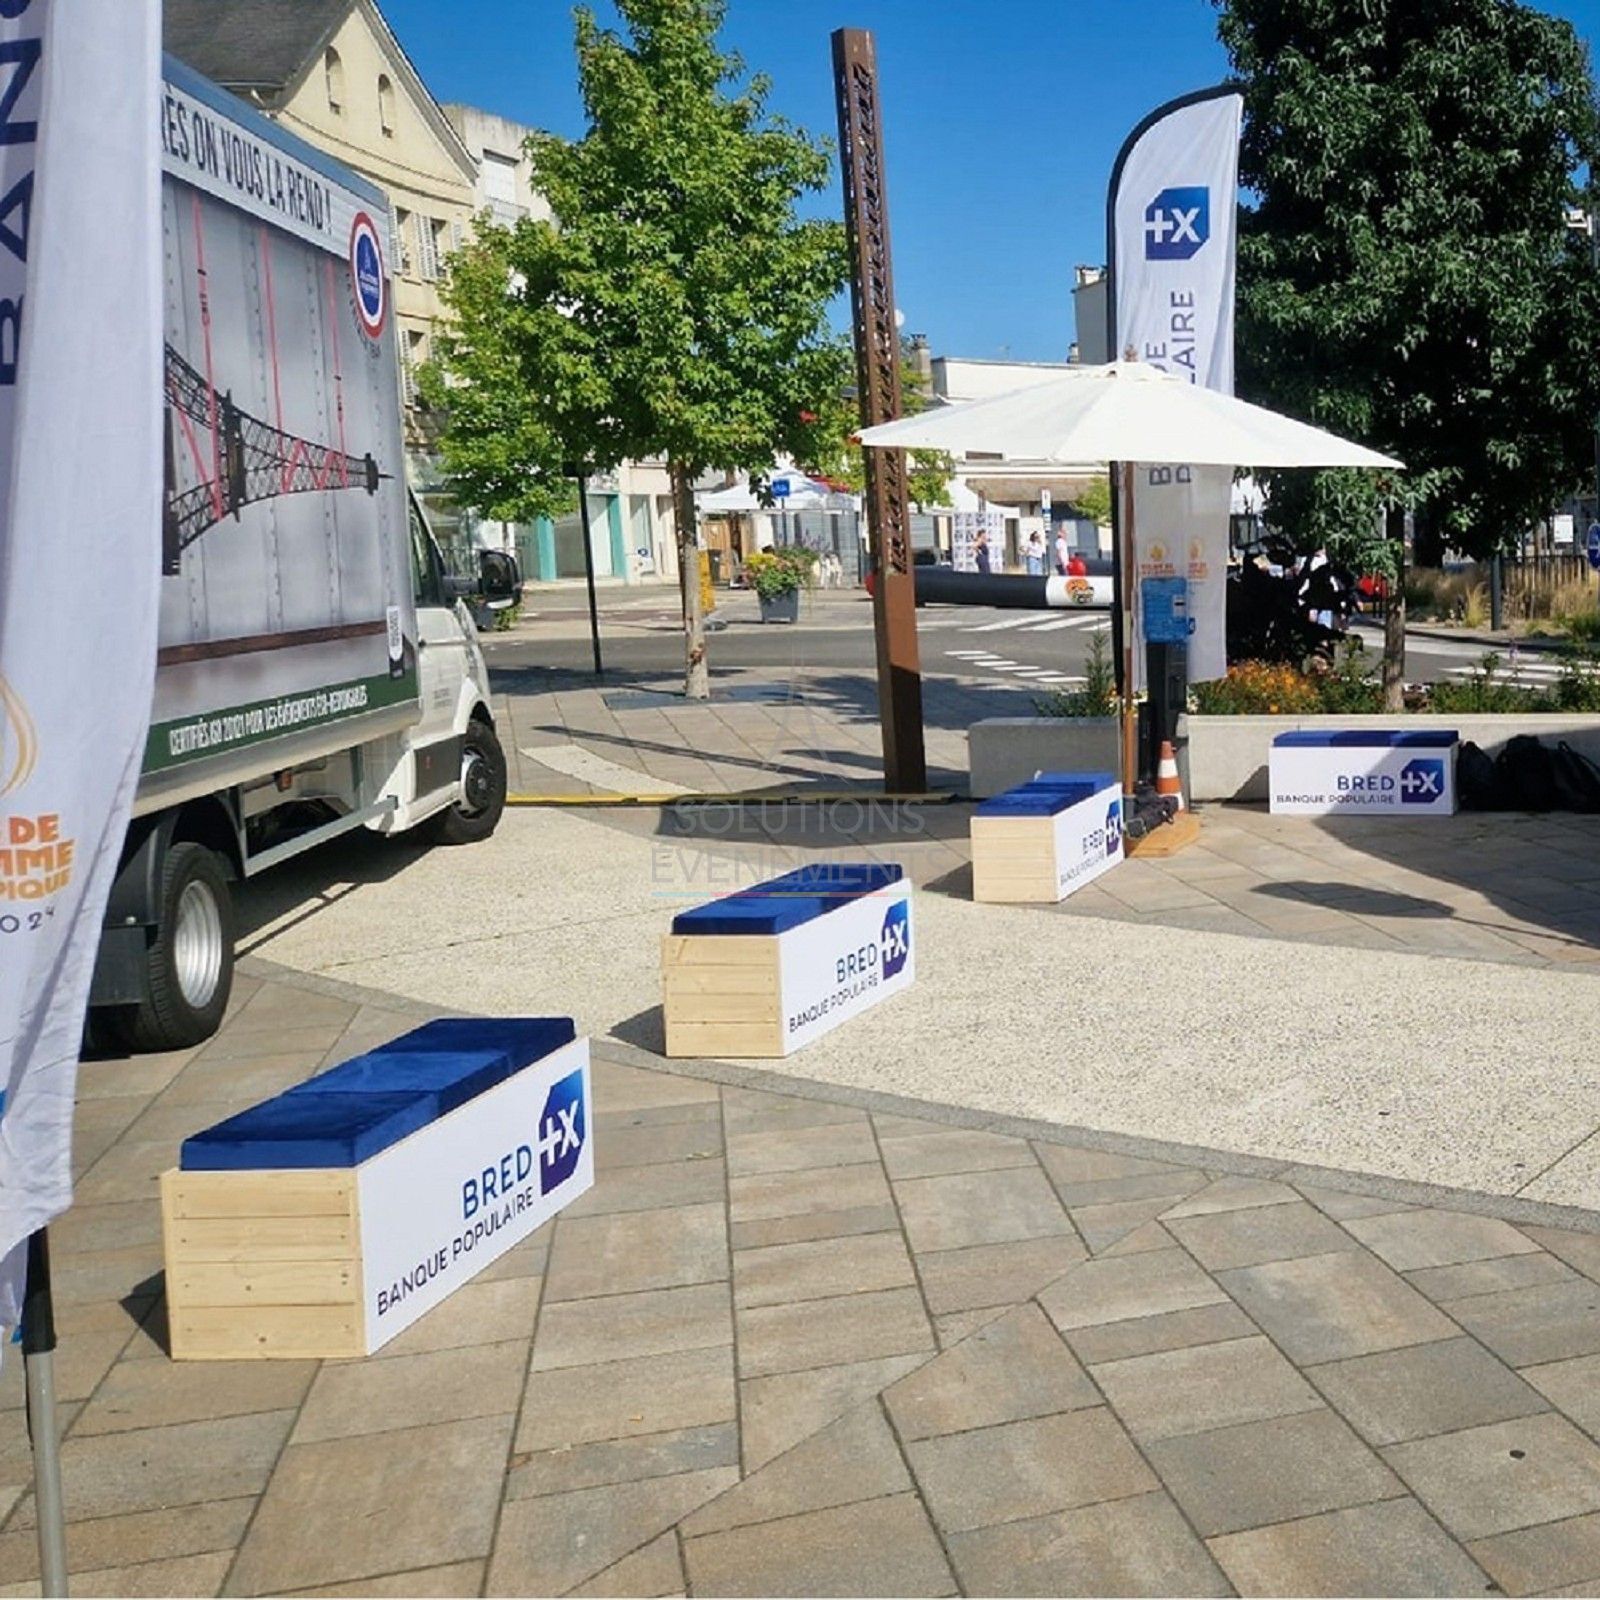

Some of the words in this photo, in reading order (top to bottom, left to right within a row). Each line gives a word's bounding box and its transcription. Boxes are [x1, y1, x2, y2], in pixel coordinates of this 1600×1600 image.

[162, 84, 189, 162] ÈS
[193, 111, 219, 178] ON
[221, 127, 264, 200] VOUS
[266, 153, 286, 212] LA
[287, 165, 323, 230] REND
[1276, 794, 1325, 804] BANQUE
[1328, 794, 1396, 805] POPULAIRE
[1337, 775, 1395, 791] BRED
[9, 814, 59, 844] DE
[836, 943, 878, 984] BRED
[789, 998, 829, 1033] BANQUE
[830, 971, 879, 1011] POPULAIRE
[462, 1144, 533, 1221] BRED
[376, 1246, 449, 1317] BANQUE
[452, 1185, 535, 1263] POPULAIRE
